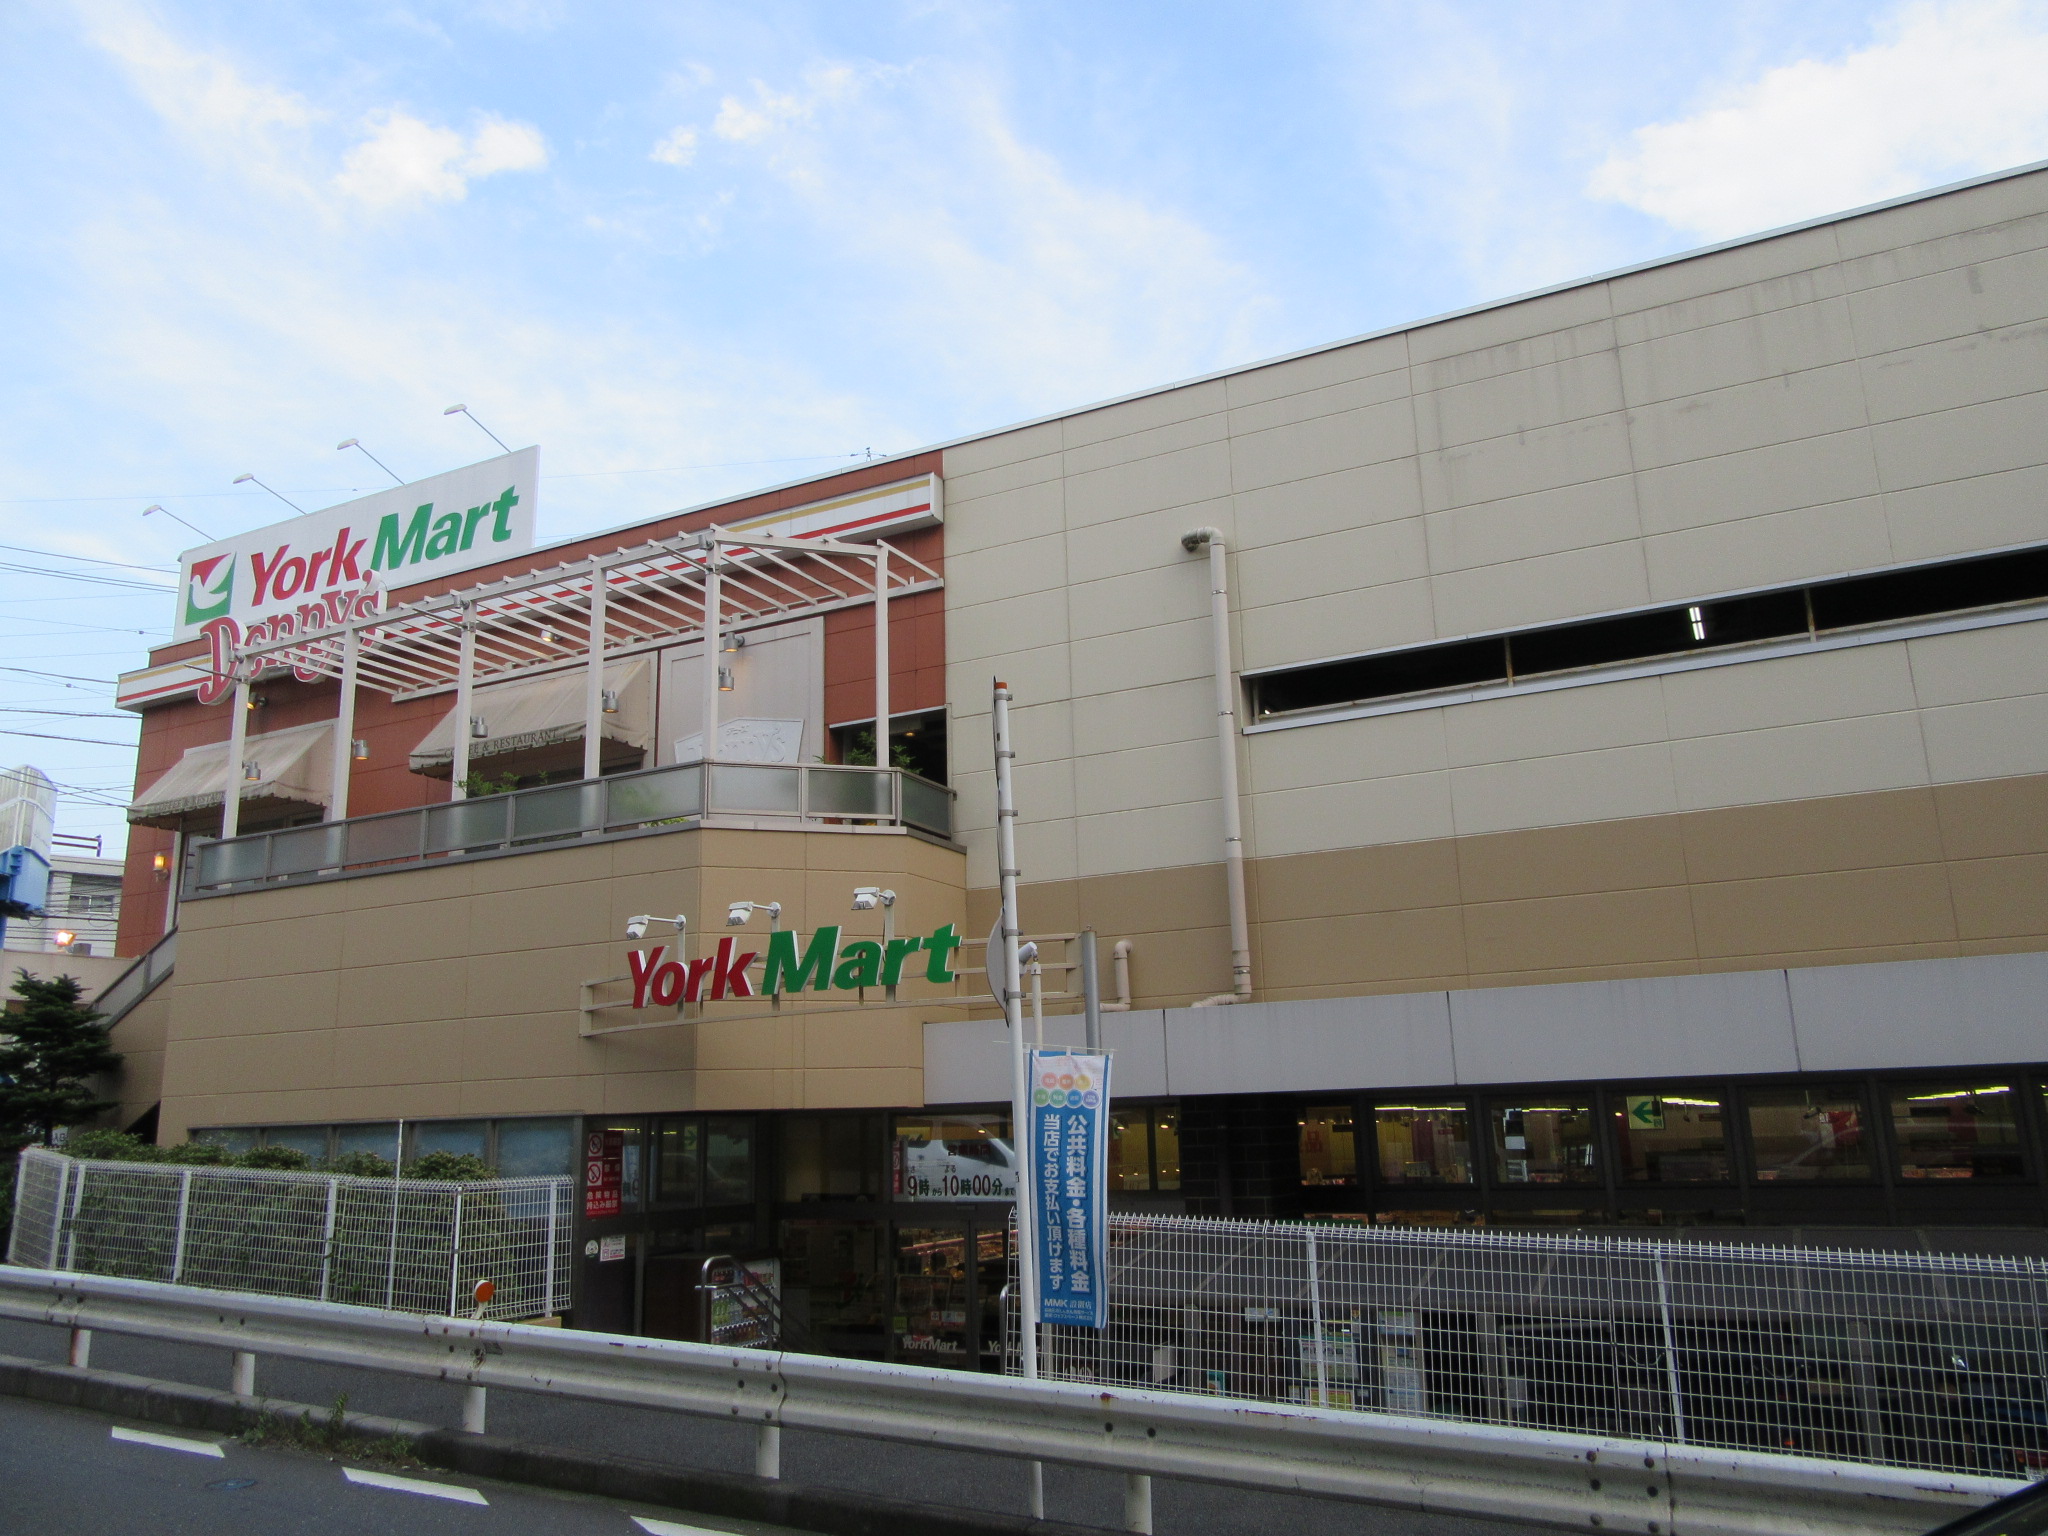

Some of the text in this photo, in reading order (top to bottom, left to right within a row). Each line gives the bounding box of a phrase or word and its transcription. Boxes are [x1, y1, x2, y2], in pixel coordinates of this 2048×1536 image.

[250, 484, 520, 608] York Mart
[493, 729, 558, 750] RESTAURANT
[627, 923, 962, 1009] York Mart
[1043, 1113, 1064, 1290] 当店でお支払い頂けます
[1065, 1114, 1091, 1293] 公共料金・各種料金
[902, 1335, 959, 1351] York Mart
